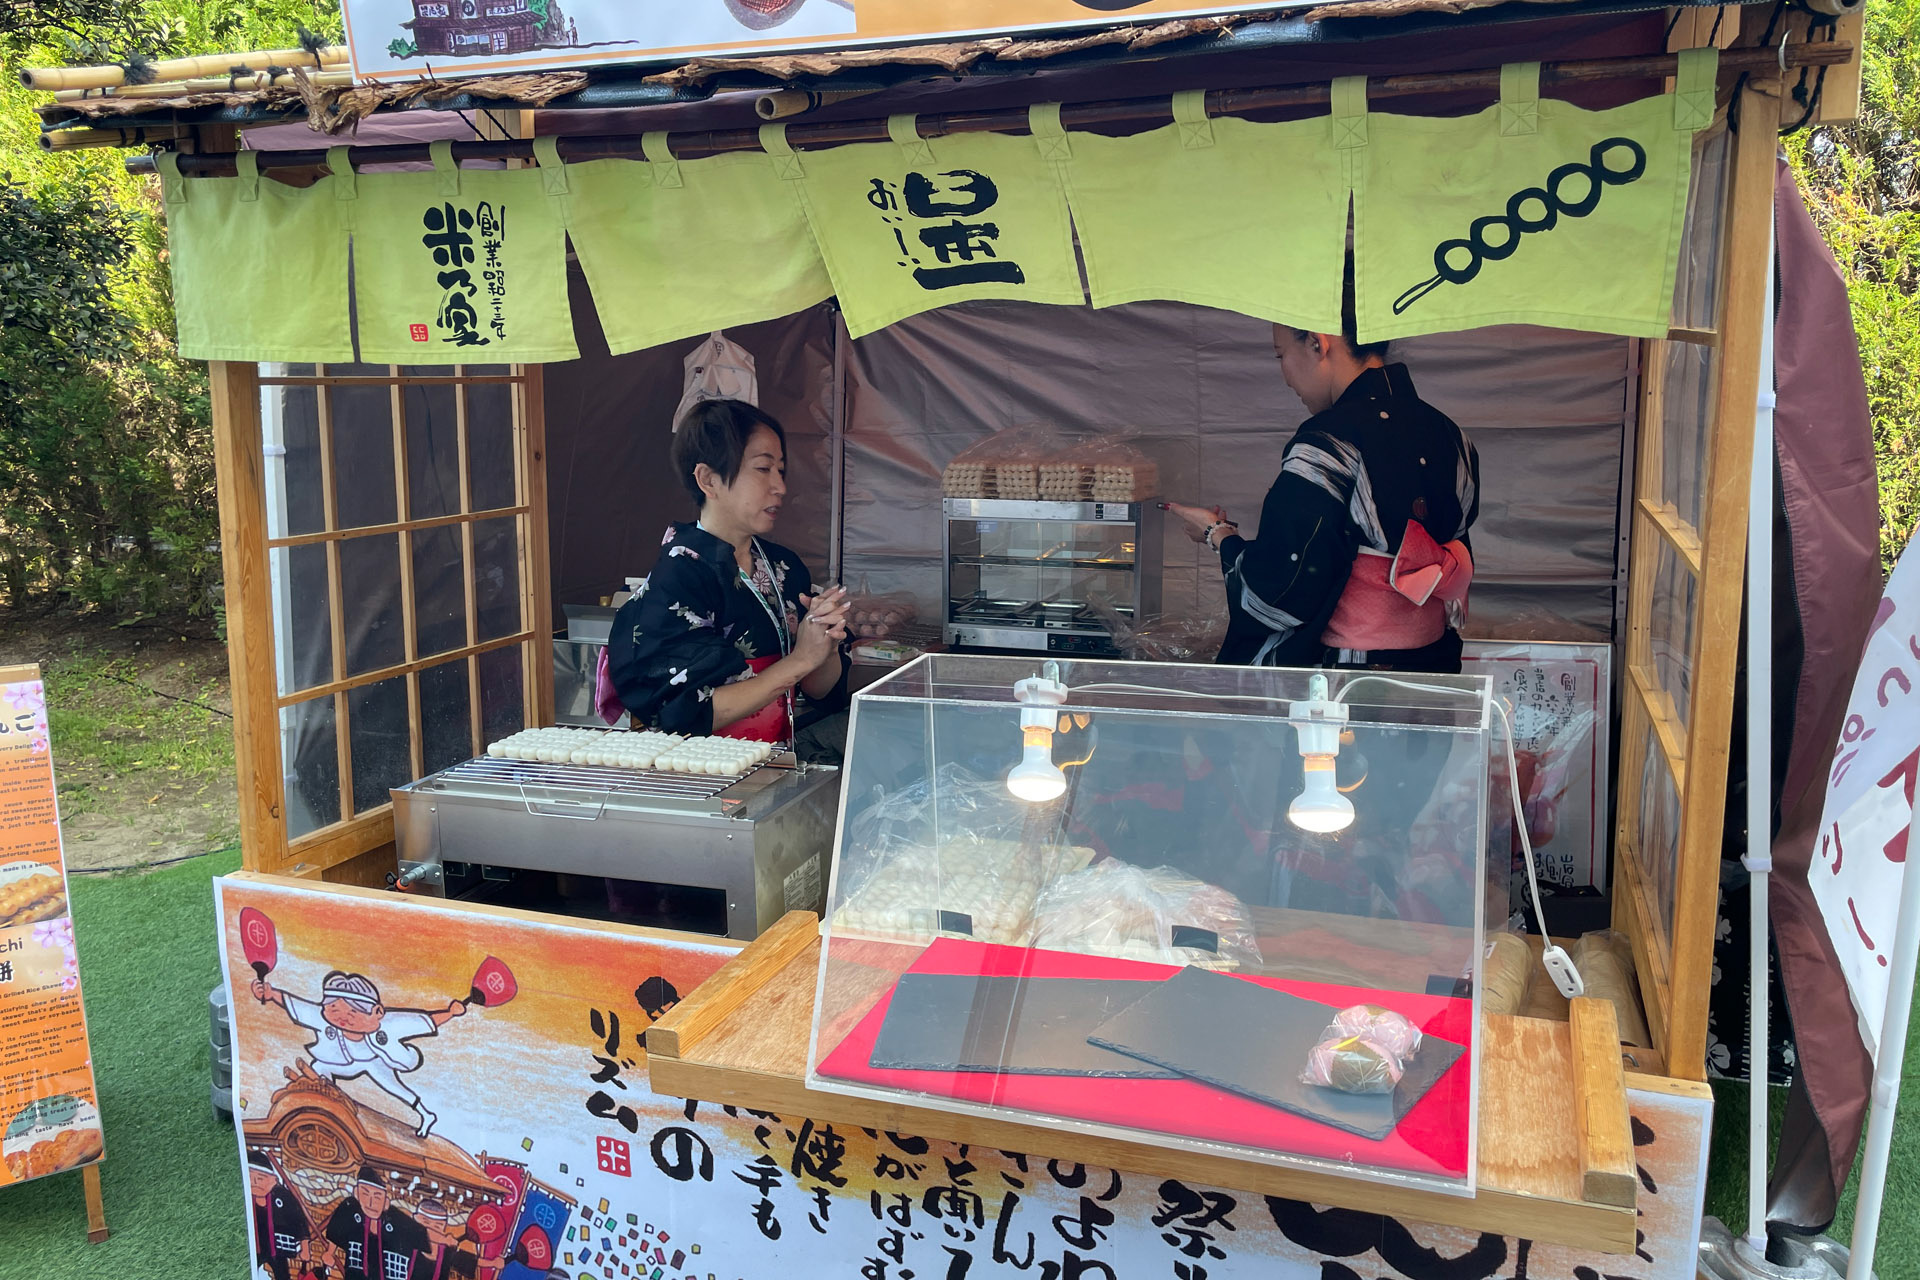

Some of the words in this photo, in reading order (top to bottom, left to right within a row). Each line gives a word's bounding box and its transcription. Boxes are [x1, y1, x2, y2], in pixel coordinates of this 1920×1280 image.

[14, 756, 48, 764] traditional
[11, 806, 44, 814] sweetness
[49, 1003, 69, 1012] grilled
[36, 1126, 52, 1134] taste
